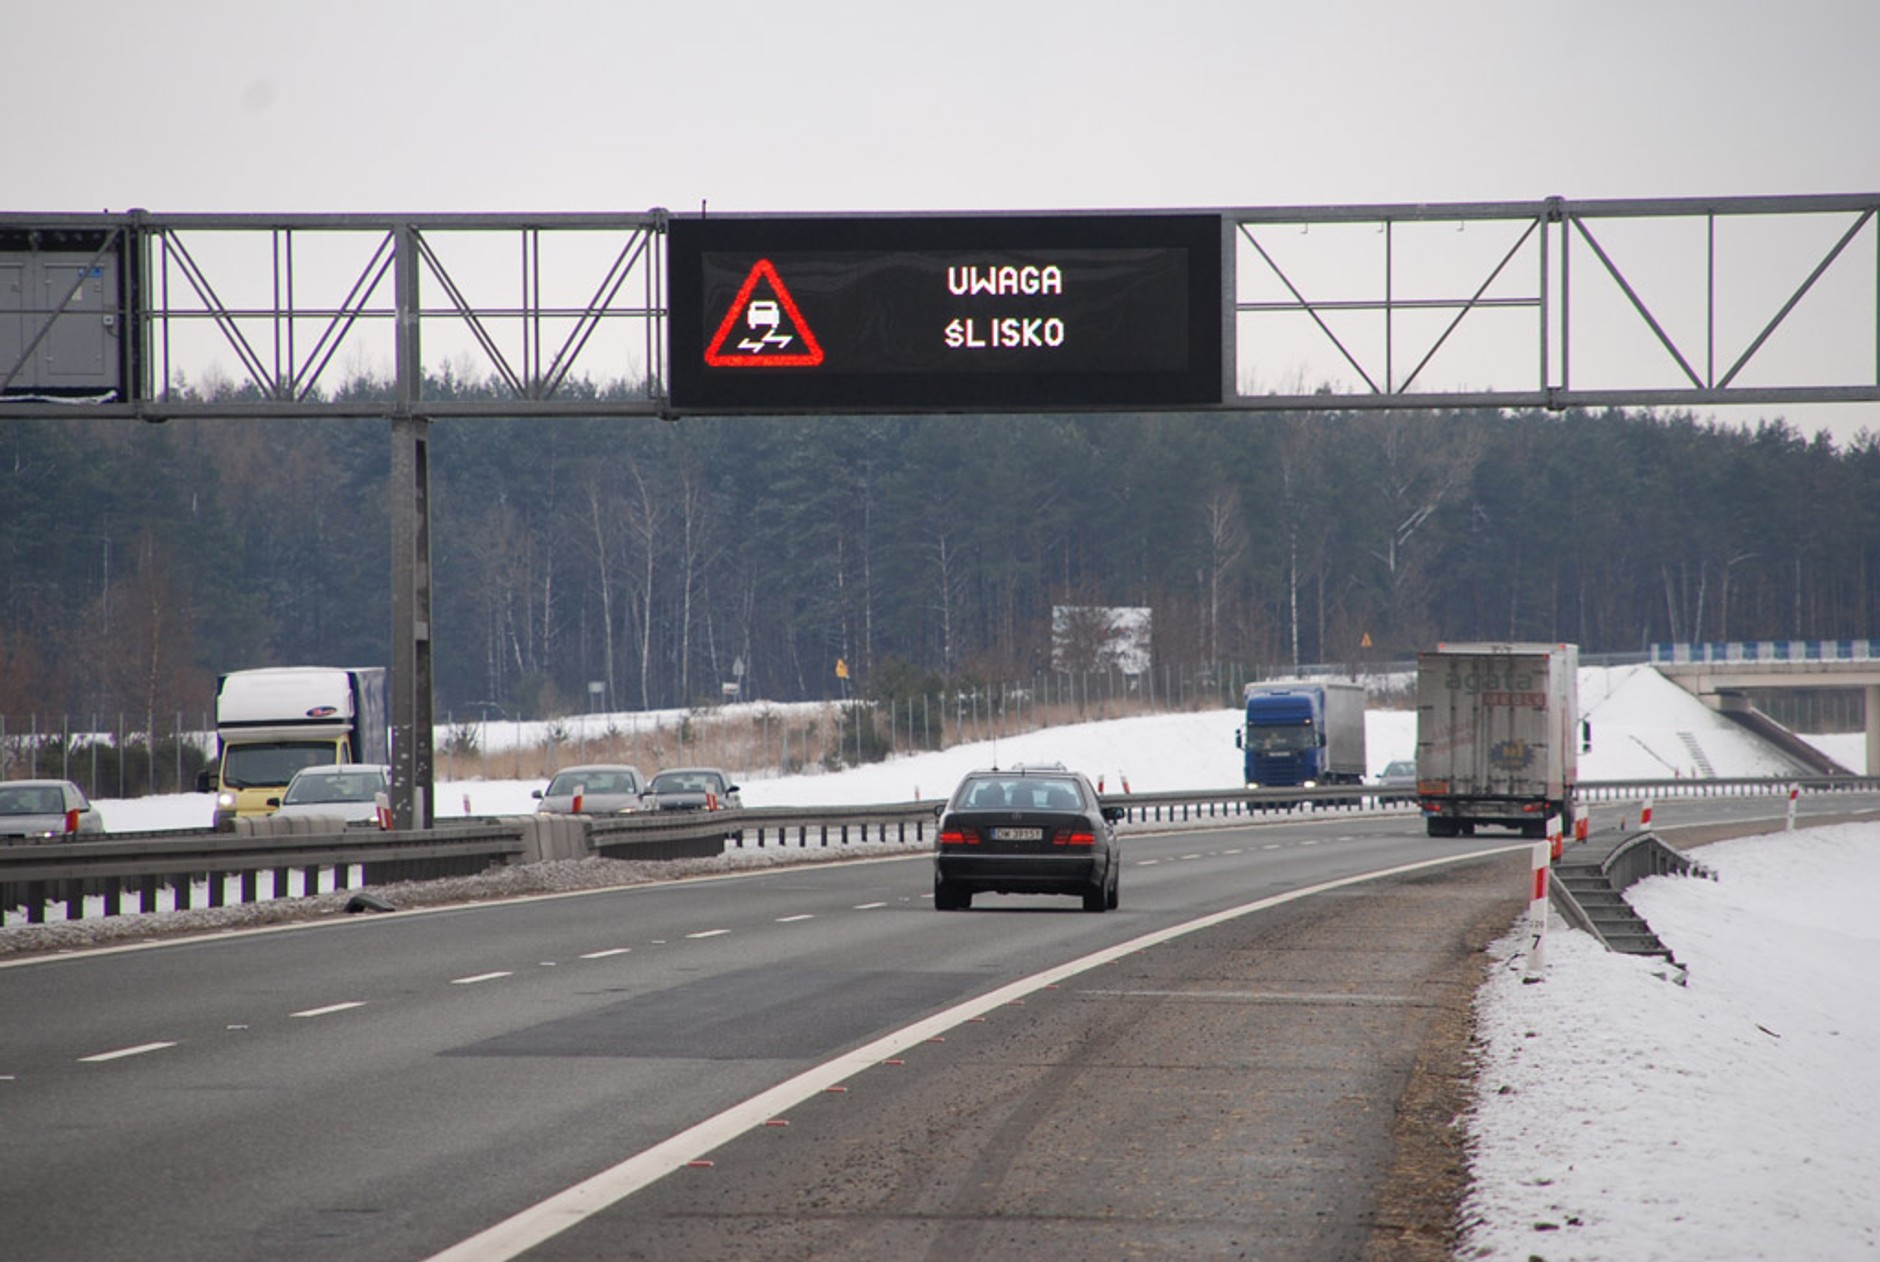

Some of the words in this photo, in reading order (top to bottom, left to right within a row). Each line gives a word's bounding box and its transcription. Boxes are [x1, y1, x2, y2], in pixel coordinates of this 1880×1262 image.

[948, 266, 1062, 295] UWAGA
[944, 318, 1065, 347] ŚLISKO
[1444, 665, 1533, 695] agata
[1531, 933, 1542, 950] 7
